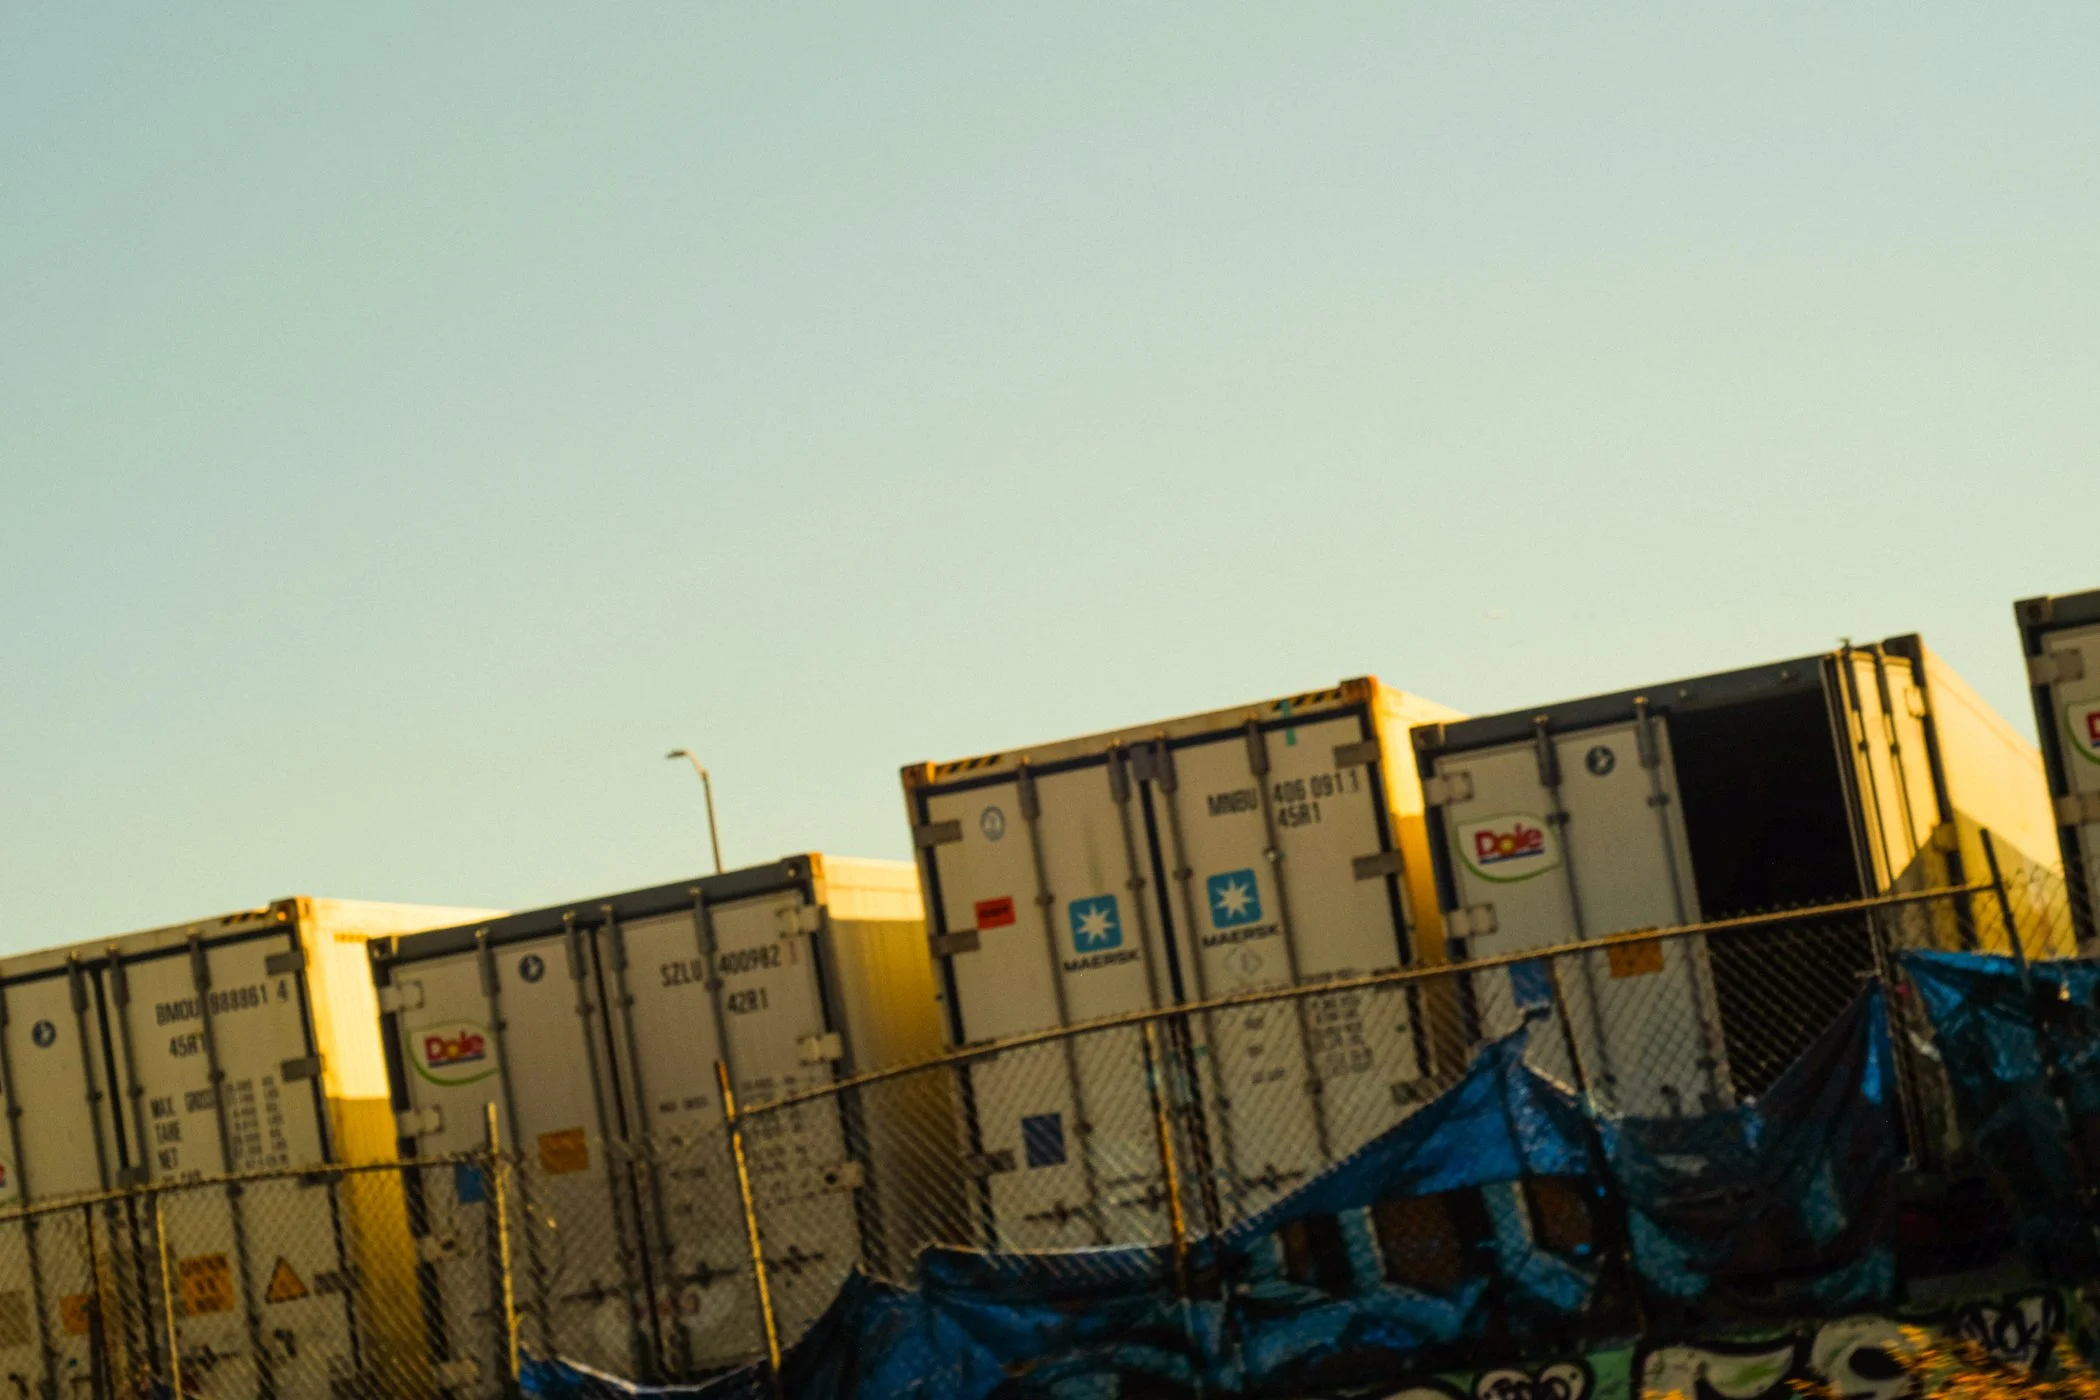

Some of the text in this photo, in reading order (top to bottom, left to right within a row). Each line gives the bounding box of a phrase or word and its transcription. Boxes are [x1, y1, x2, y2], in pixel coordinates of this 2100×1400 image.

[1278, 801, 1322, 829] 45R1
[1474, 823, 1545, 859] Dole
[1203, 924, 1281, 948] MAERSK
[1064, 949, 1141, 973] MAERSK
[424, 1029, 485, 1061] Dole
